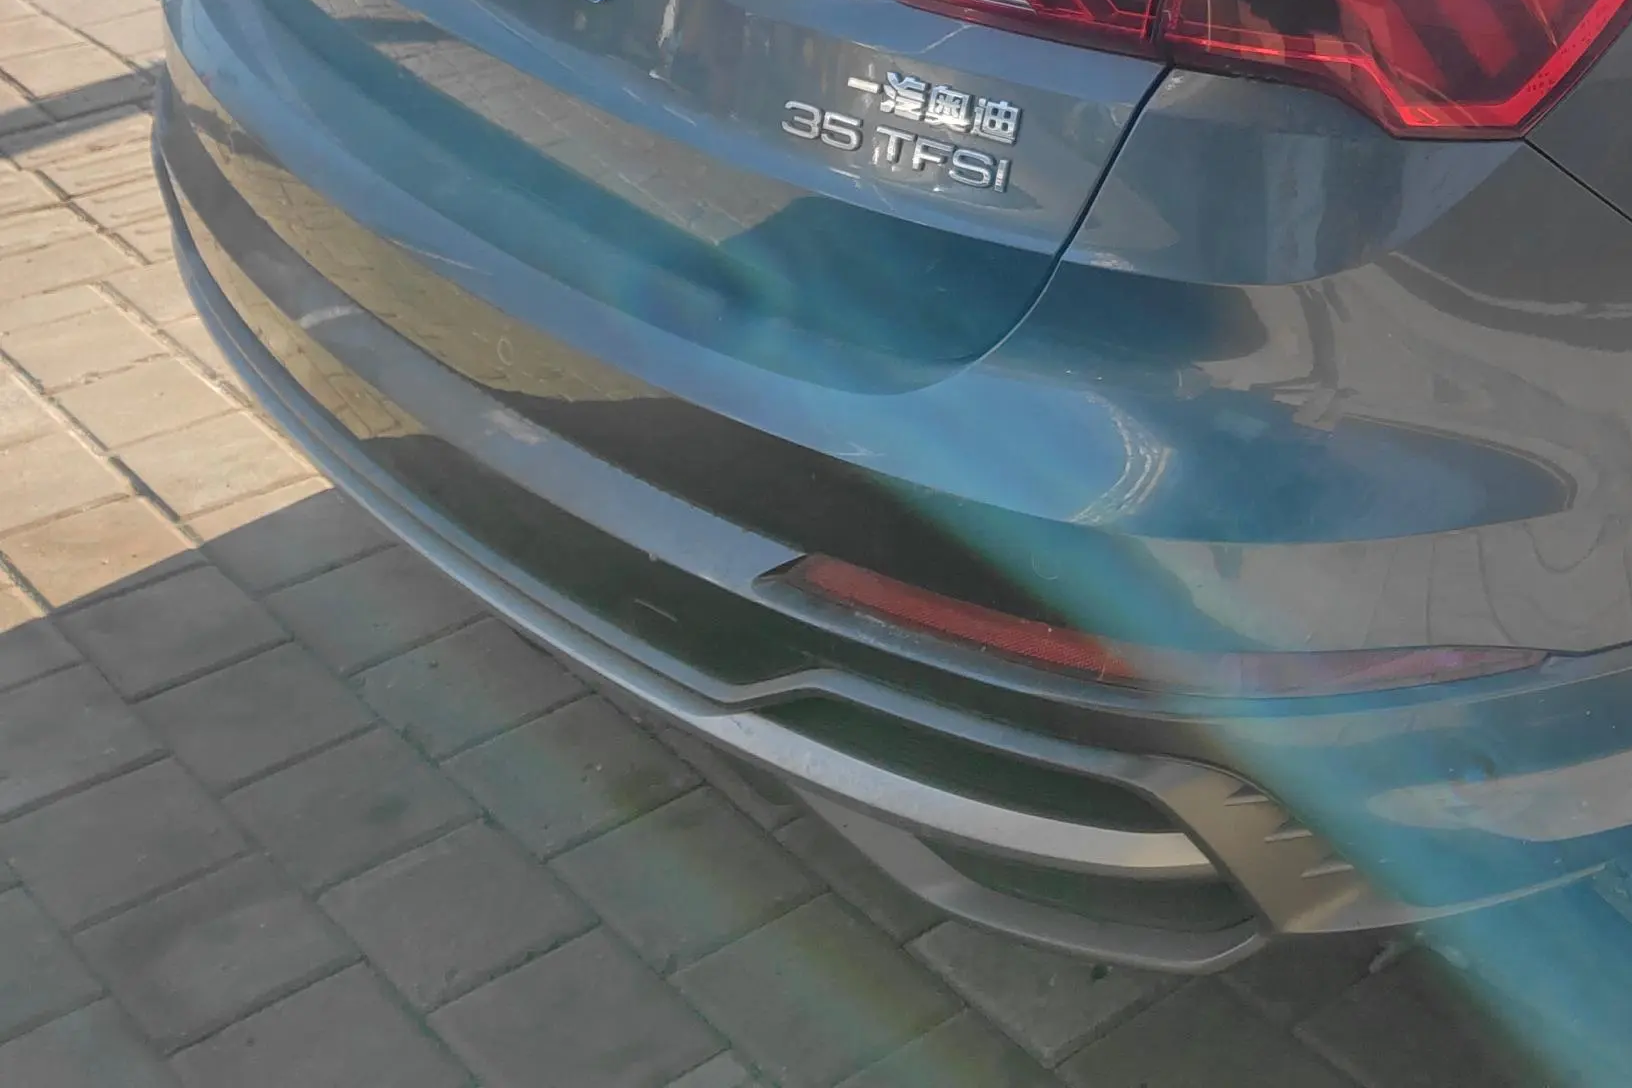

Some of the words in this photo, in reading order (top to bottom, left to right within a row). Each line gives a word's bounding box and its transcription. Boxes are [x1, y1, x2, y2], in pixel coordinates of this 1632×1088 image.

[781, 100, 863, 151] 35
[876, 125, 1012, 193] TFSI
[847, 71, 1022, 146] 一汽奥迪
